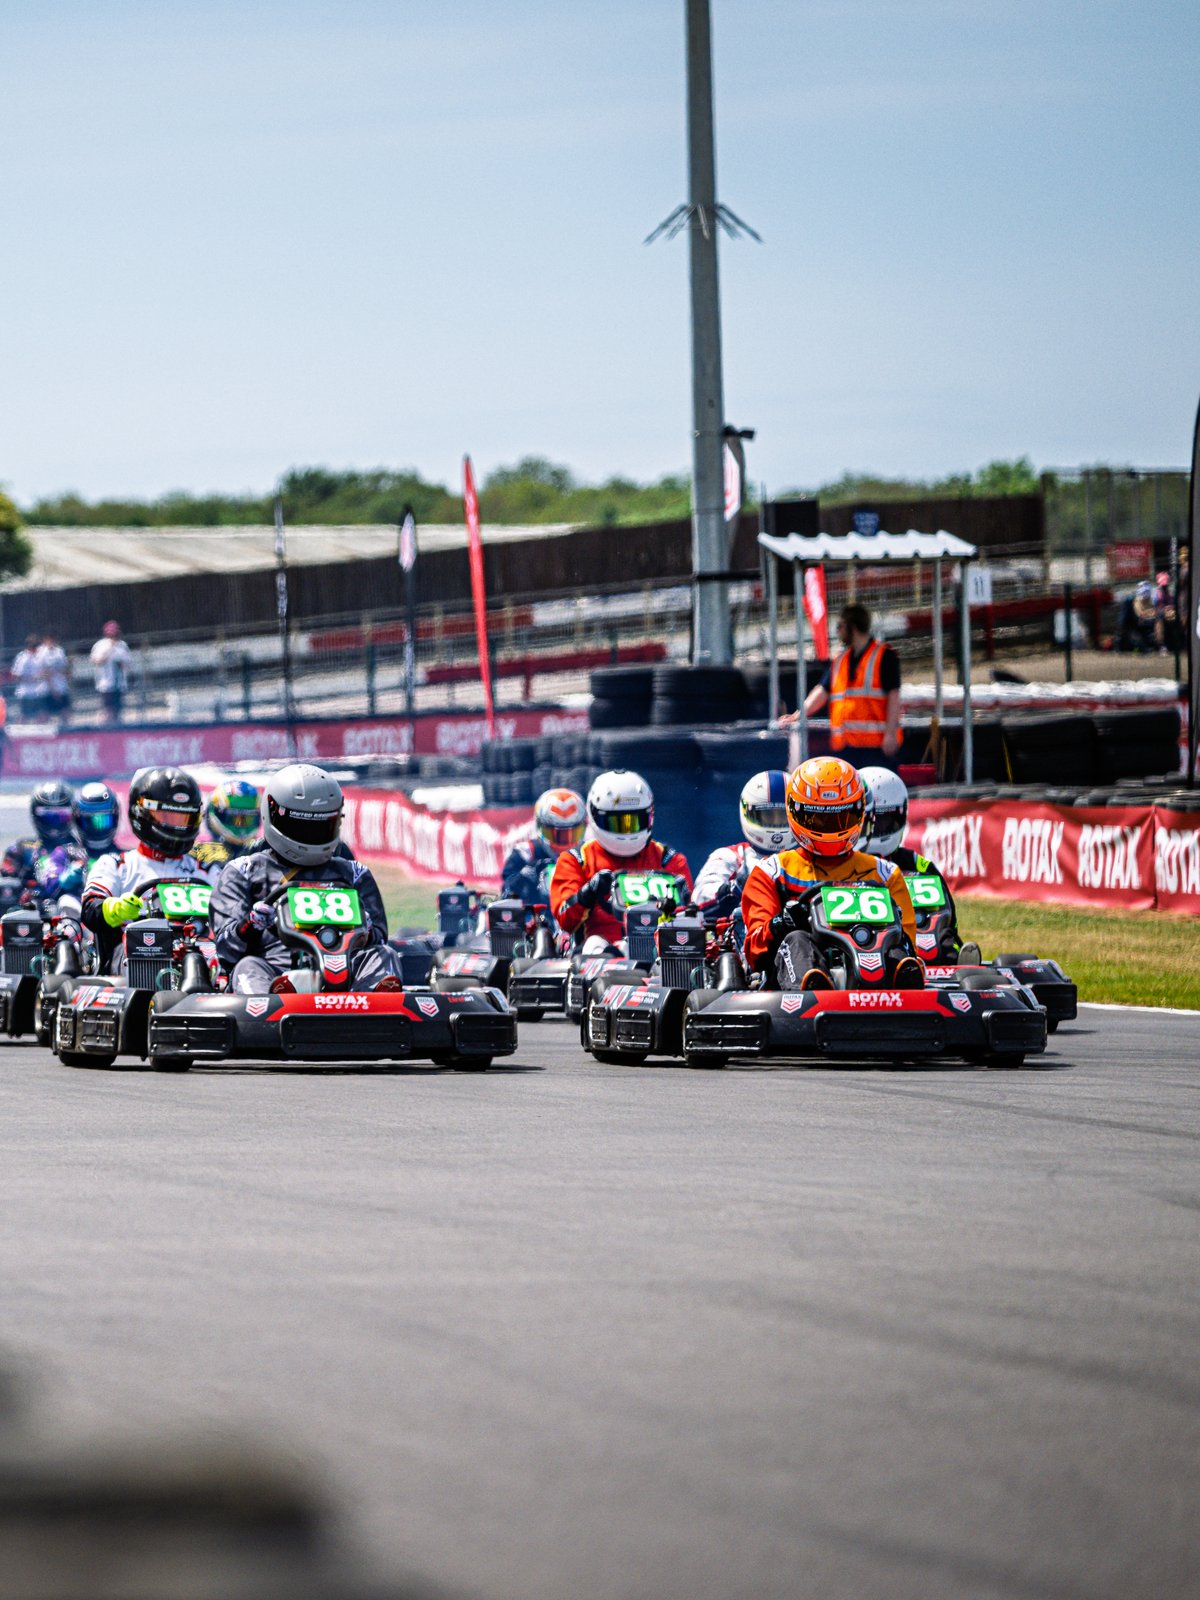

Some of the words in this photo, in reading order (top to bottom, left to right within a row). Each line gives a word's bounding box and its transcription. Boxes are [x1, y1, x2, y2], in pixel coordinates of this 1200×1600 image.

[920, 815, 986, 877] ROTAX
[1003, 817, 1064, 884] ROTAX
[1078, 824, 1142, 889] ROTAX
[1155, 826, 1200, 895] ROTA
[163, 886, 212, 913] 86
[623, 877, 674, 902] 50
[294, 891, 354, 922] 88
[827, 890, 888, 920] 26
[315, 995, 368, 1005] ROTAX
[849, 992, 901, 1002] ROTAX
